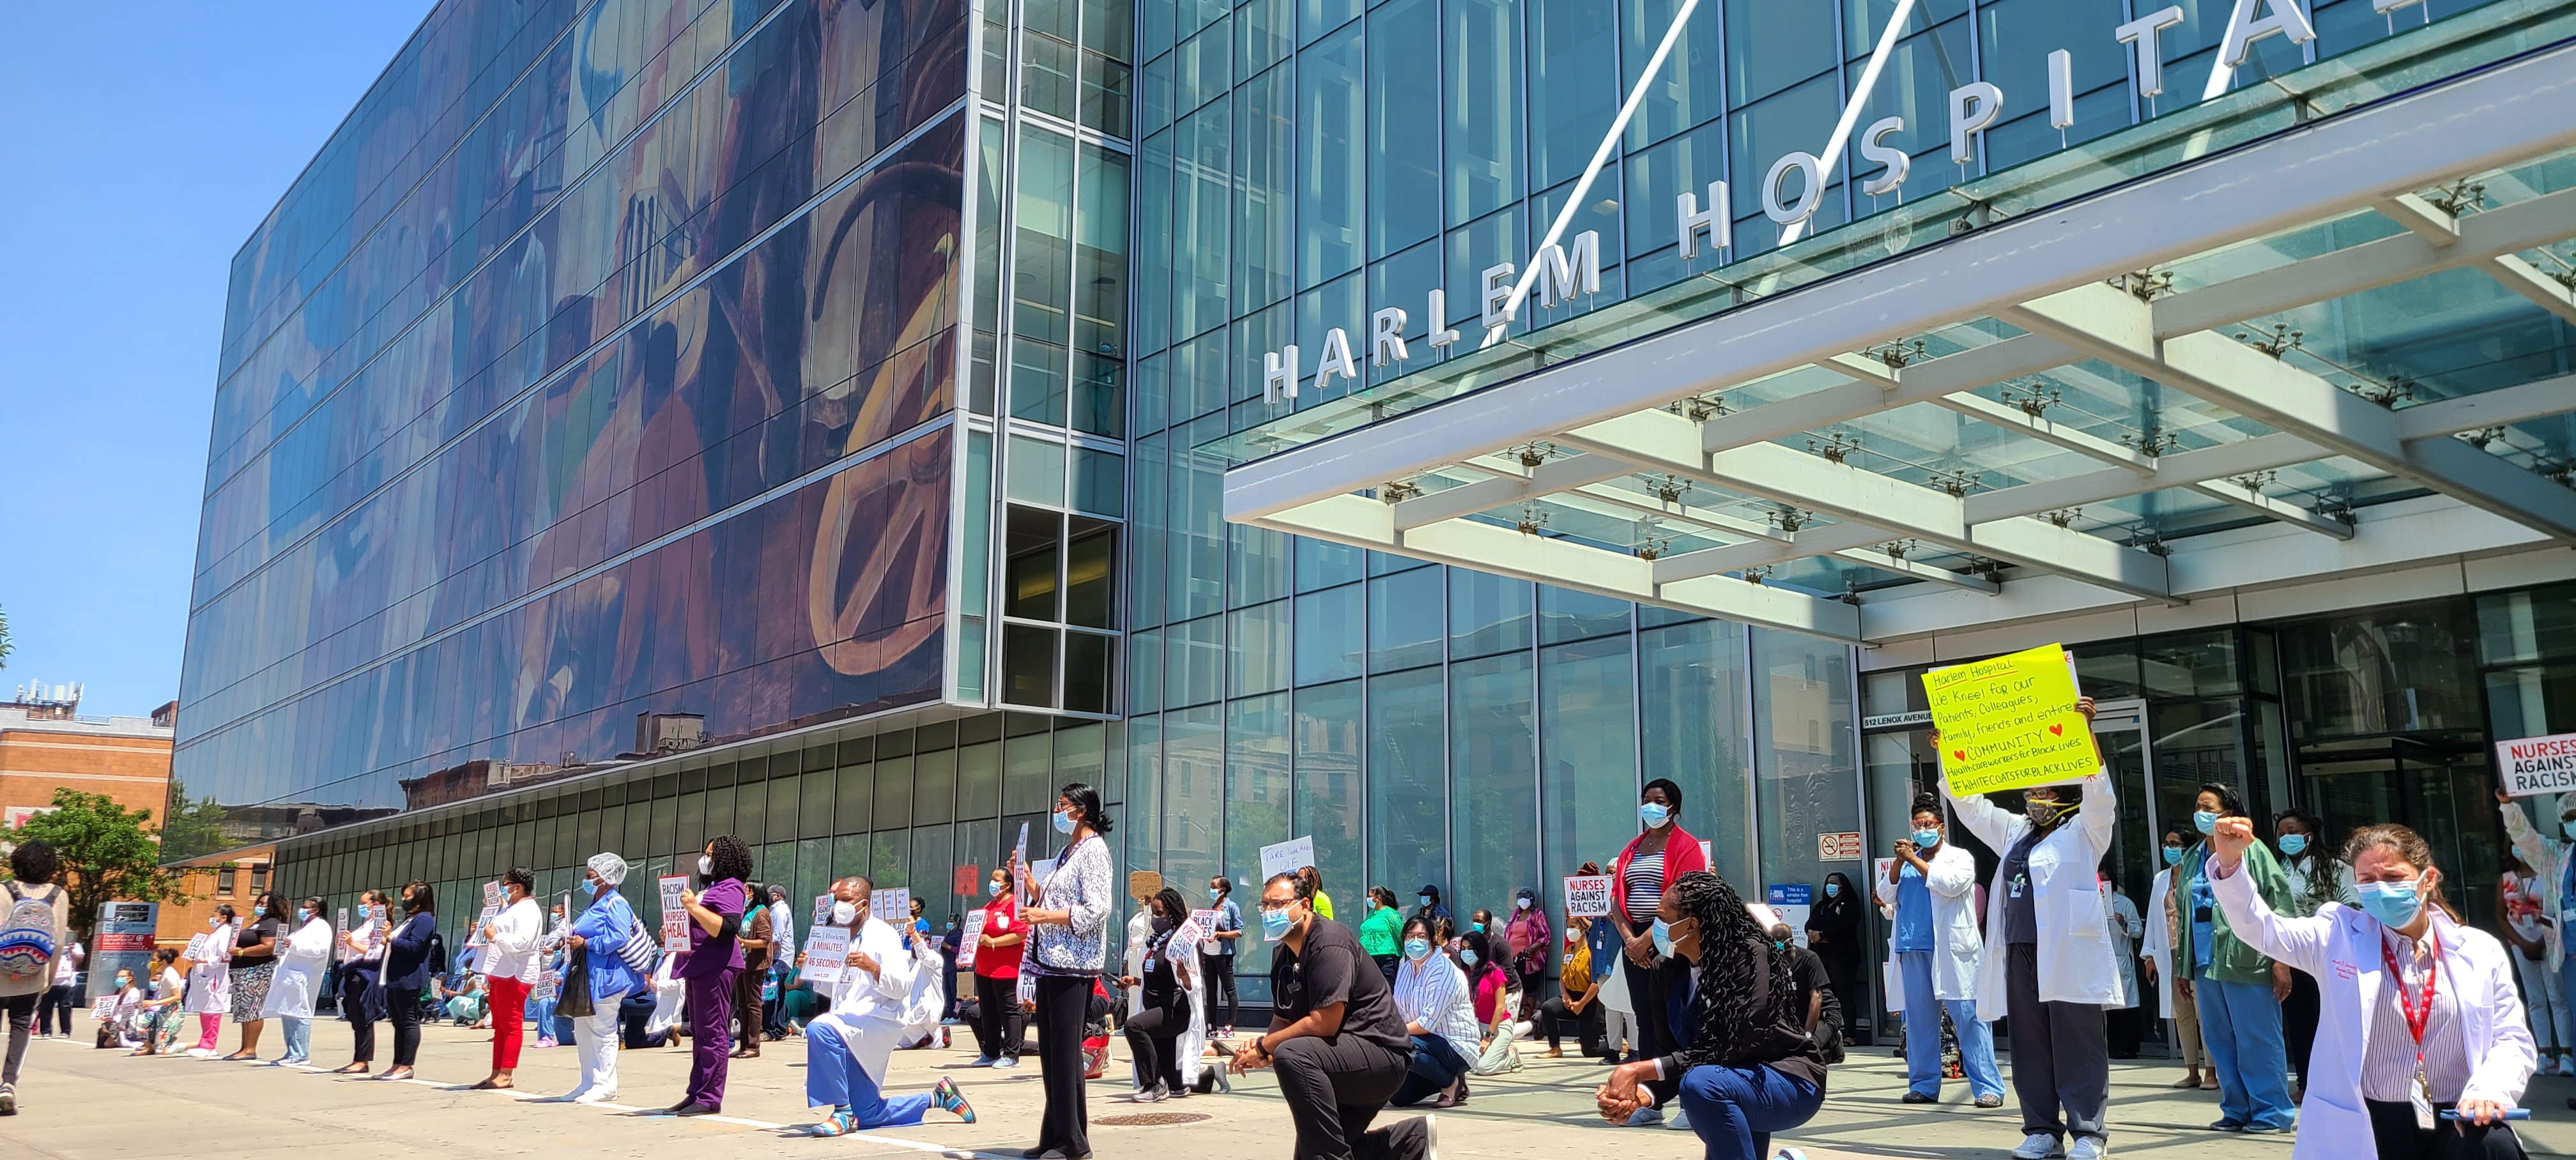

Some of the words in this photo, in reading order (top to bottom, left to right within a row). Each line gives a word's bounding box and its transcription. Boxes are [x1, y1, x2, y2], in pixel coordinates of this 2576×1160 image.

[1264, 230, 1600, 404] HARLEM
[1677, 0, 2425, 259] HOSPITA
[1933, 671, 1966, 687] Harlem
[1931, 693, 1949, 707] We
[1952, 688, 1985, 703] Kneel
[2014, 677, 2035, 692] our
[1938, 708, 1977, 726] Patients,
[1979, 695, 2039, 713] Colleagues,
[1864, 718, 1876, 726] 512
[1878, 715, 1901, 724] LENOX
[1903, 712, 1933, 722] AVENUE
[1942, 726, 1975, 744] family,
[1976, 719, 2011, 735] friends
[2014, 712, 2034, 726] and
[2037, 703, 2073, 720] entire
[1967, 729, 2043, 761] COMMUNITY
[2031, 745, 2057, 757] Black
[2058, 738, 2082, 751] Lives
[2510, 739, 2576, 759] NURSES
[1951, 757, 2092, 793] #WHITECOATSFORBLACKLIVES
[1263, 848, 1284, 862] TAKE
[663, 883, 684, 895] RACISM
[1570, 879, 1605, 891] NURSES
[1571, 890, 1606, 901] AGAINST
[1571, 901, 1606, 913] RACISM
[665, 912, 686, 922] NURSES
[968, 914, 983, 923] RACISM
[666, 922, 687, 938] HEAL
[965, 923, 981, 934] KILLS
[812, 941, 816, 949] 8
[817, 942, 842, 952] MINUTES
[960, 942, 974, 955] HEAL
[808, 958, 815, 966] 46
[816, 958, 841, 968] SECONDS
[537, 987, 553, 996] RACISM
